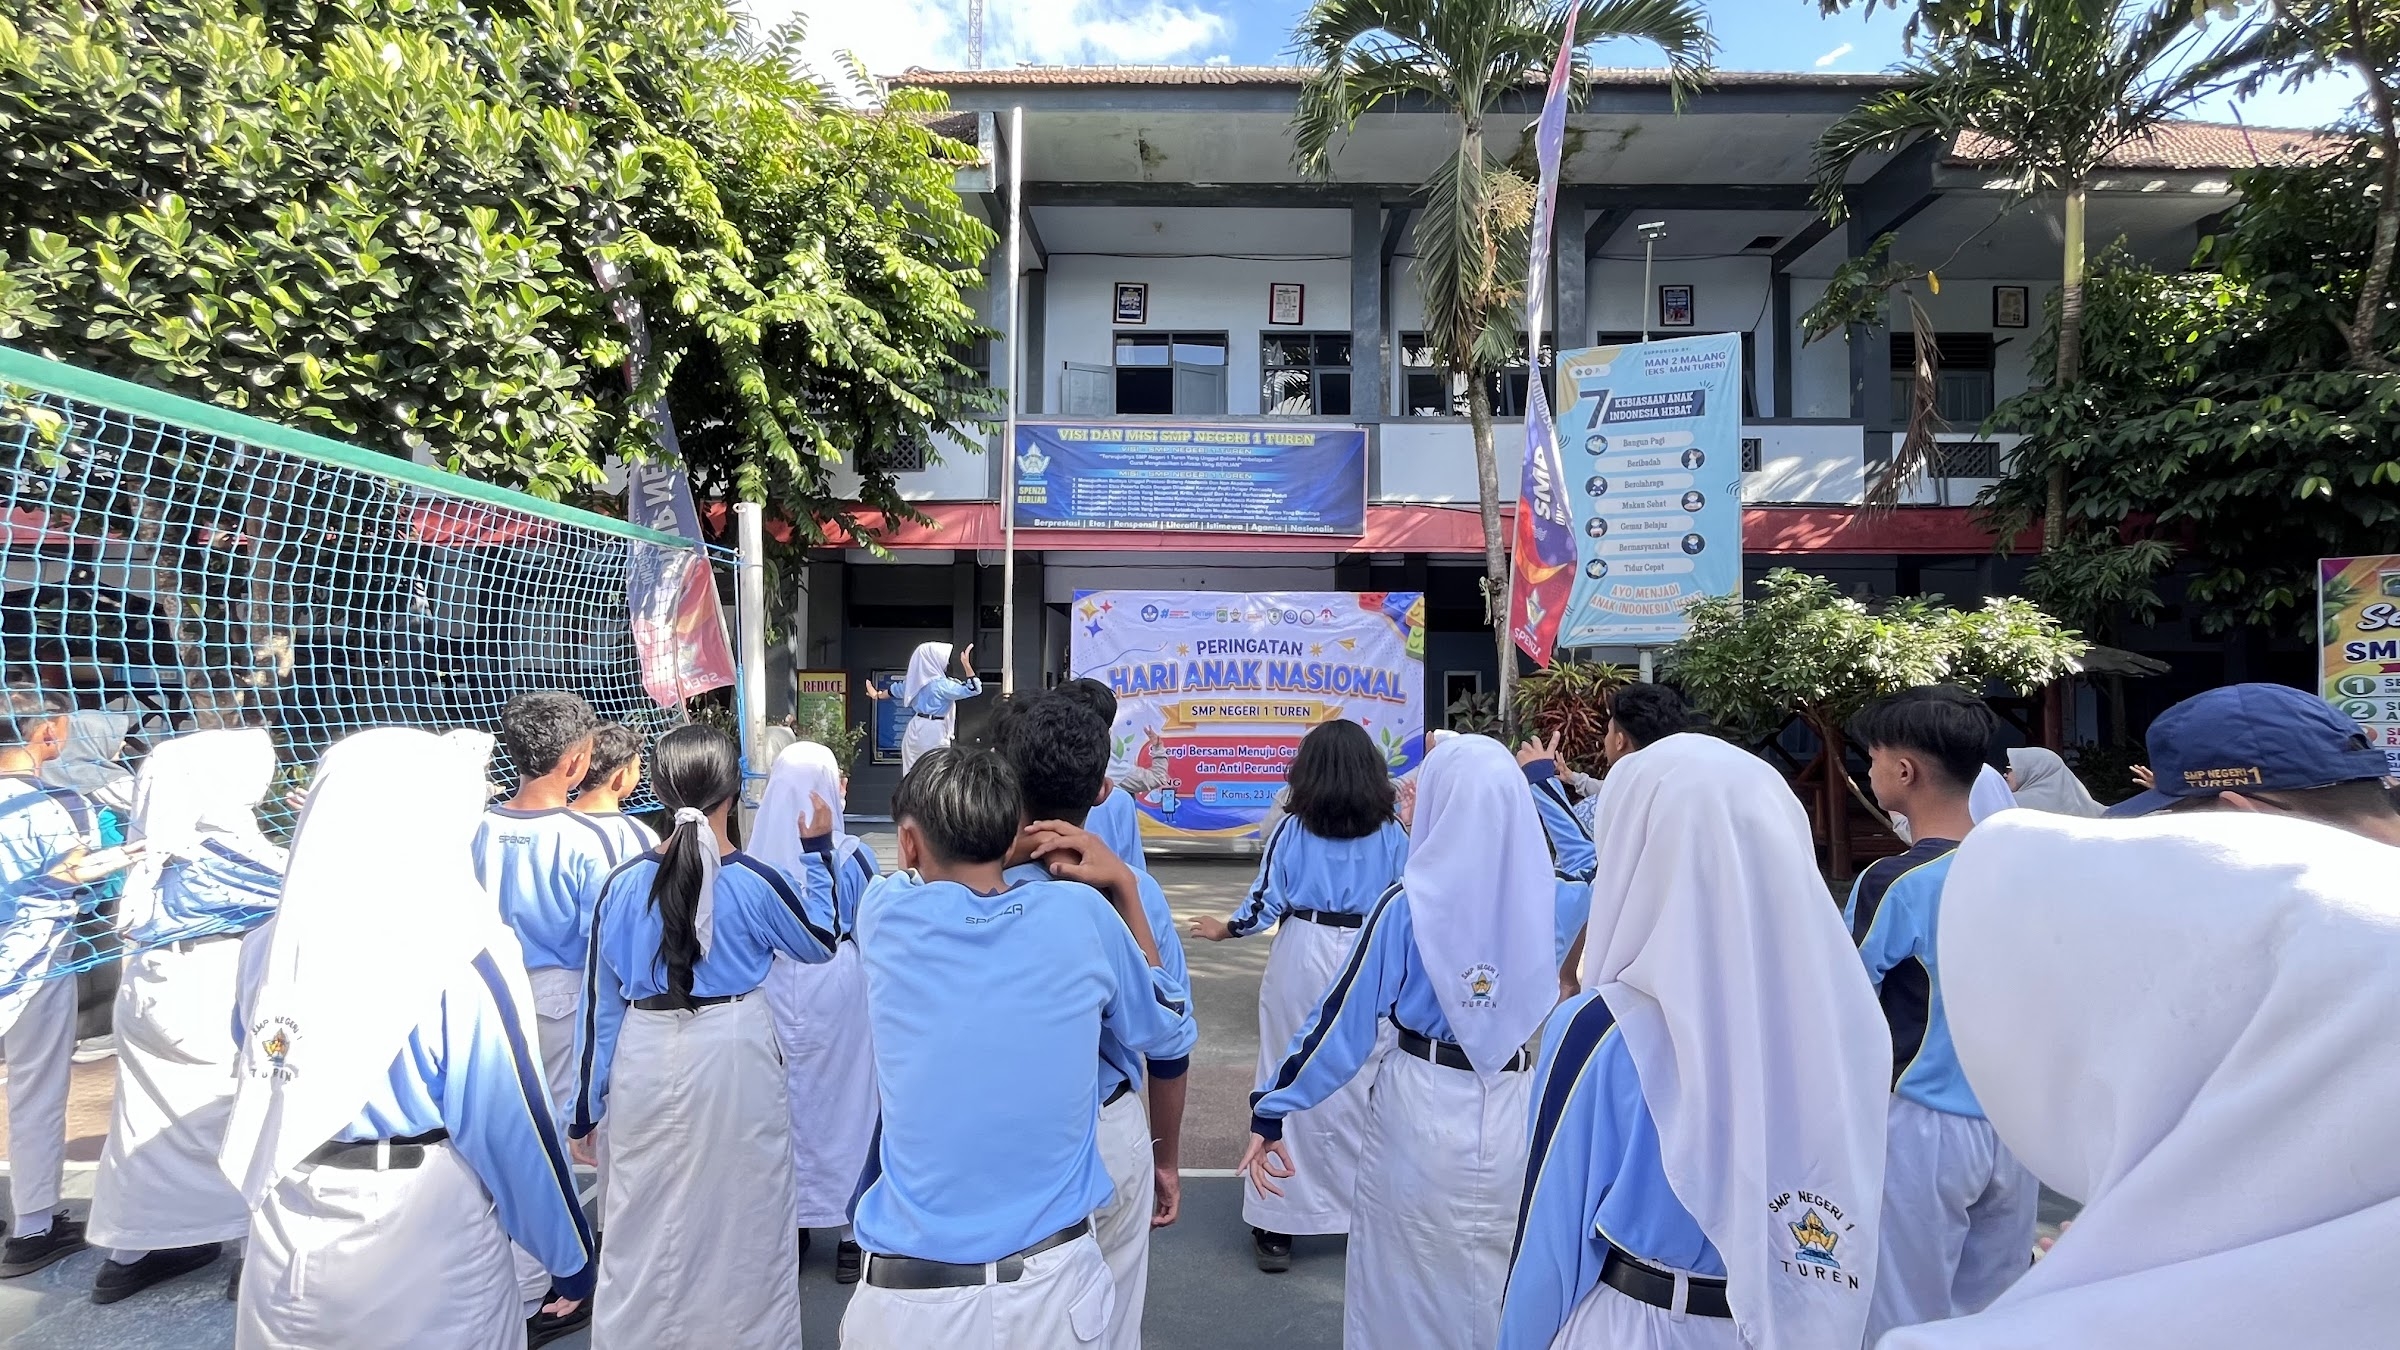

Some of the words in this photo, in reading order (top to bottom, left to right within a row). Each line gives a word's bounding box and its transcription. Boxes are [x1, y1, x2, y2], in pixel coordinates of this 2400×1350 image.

[1645, 358, 1669, 367] MAN
[1671, 357, 1677, 365] 2
[1680, 352, 1726, 364] MALANG
[1669, 365, 1690, 373] MAN
[1692, 361, 1726, 372] TUREN)
[1615, 397, 1666, 408] KEBIASAAN
[1667, 392, 1694, 402] ANAK
[1579, 389, 1611, 430] 7
[1609, 408, 1659, 421] INDONESIA
[1661, 405, 1693, 416] HEBAT
[1057, 428, 1089, 441] VISI
[1090, 429, 1123, 442] DAN
[1124, 430, 1159, 442] MISI
[1159, 431, 1193, 443] SMP
[1194, 432, 1250, 444] NEGERI
[1252, 432, 1262, 444] 1
[1264, 433, 1315, 446] TUREN
[1623, 438, 1648, 448] Bangun
[1650, 436, 1665, 446] Pagi
[1627, 458, 1661, 467] Beribadah
[1532, 445, 1551, 520] SMP
[1624, 480, 1664, 489] Berolahraga
[1019, 487, 1046, 495] SPENZA
[1017, 495, 1047, 504] BERLIAN
[1622, 501, 1645, 509] Makan
[1646, 500, 1667, 508] Sehat
[1034, 519, 1080, 528] Berprestasi
[1089, 519, 1106, 527] Etos
[1114, 520, 1158, 529] Rensponsif
[1167, 521, 1198, 530] Literatif
[1206, 522, 1243, 530] Istimewa
[1251, 523, 1282, 532] Agamis
[1291, 523, 1334, 533] Nasionalis
[1620, 522, 1642, 530] Gemar
[1644, 520, 1668, 530] Belajar
[1619, 542, 1670, 552] Bermasyarakat
[1624, 564, 1643, 572] Tidur
[1644, 563, 1664, 572] Cepat
[1611, 586, 1632, 598] AYO
[1634, 584, 1680, 599] MENJADI
[1590, 595, 1615, 611] ANAK
[1196, 638, 1304, 656] PERINGATAN
[2344, 639, 2400, 664] SM
[803, 680, 843, 693] REDUCE
[1107, 661, 1178, 698] HARI
[1182, 658, 1261, 691] ANAK
[1266, 659, 1408, 703] NASIONAL
[2351, 679, 2366, 694] 1
[1191, 704, 1216, 717] SMP
[1219, 704, 1260, 717] NEGERI
[1263, 705, 1269, 717] 1
[1273, 705, 1312, 718] TUREN
[2350, 702, 2370, 718] 2
[1149, 744, 1187, 759] ergi
[1189, 745, 1234, 757] Bersama
[1237, 745, 1276, 759] Menuju
[1196, 761, 1217, 774] dan
[1219, 761, 1241, 773] Anti
[2183, 770, 2205, 780] SMP
[2207, 767, 2247, 779] NEGERI
[2247, 766, 2263, 784] 1
[2186, 777, 2248, 788] TUREN
[1221, 789, 1252, 801] Kamis,
[1254, 790, 1265, 799] 23
[498, 834, 531, 845] SPENZA
[965, 903, 1024, 925] SPZA
[1461, 1000, 1498, 1009] TUREN
[1768, 1192, 1791, 1213] SMP
[1798, 1191, 1844, 1220] NEGERI
[1845, 1223, 1856, 1232] 1
[1781, 1259, 1859, 1290] TUREN
